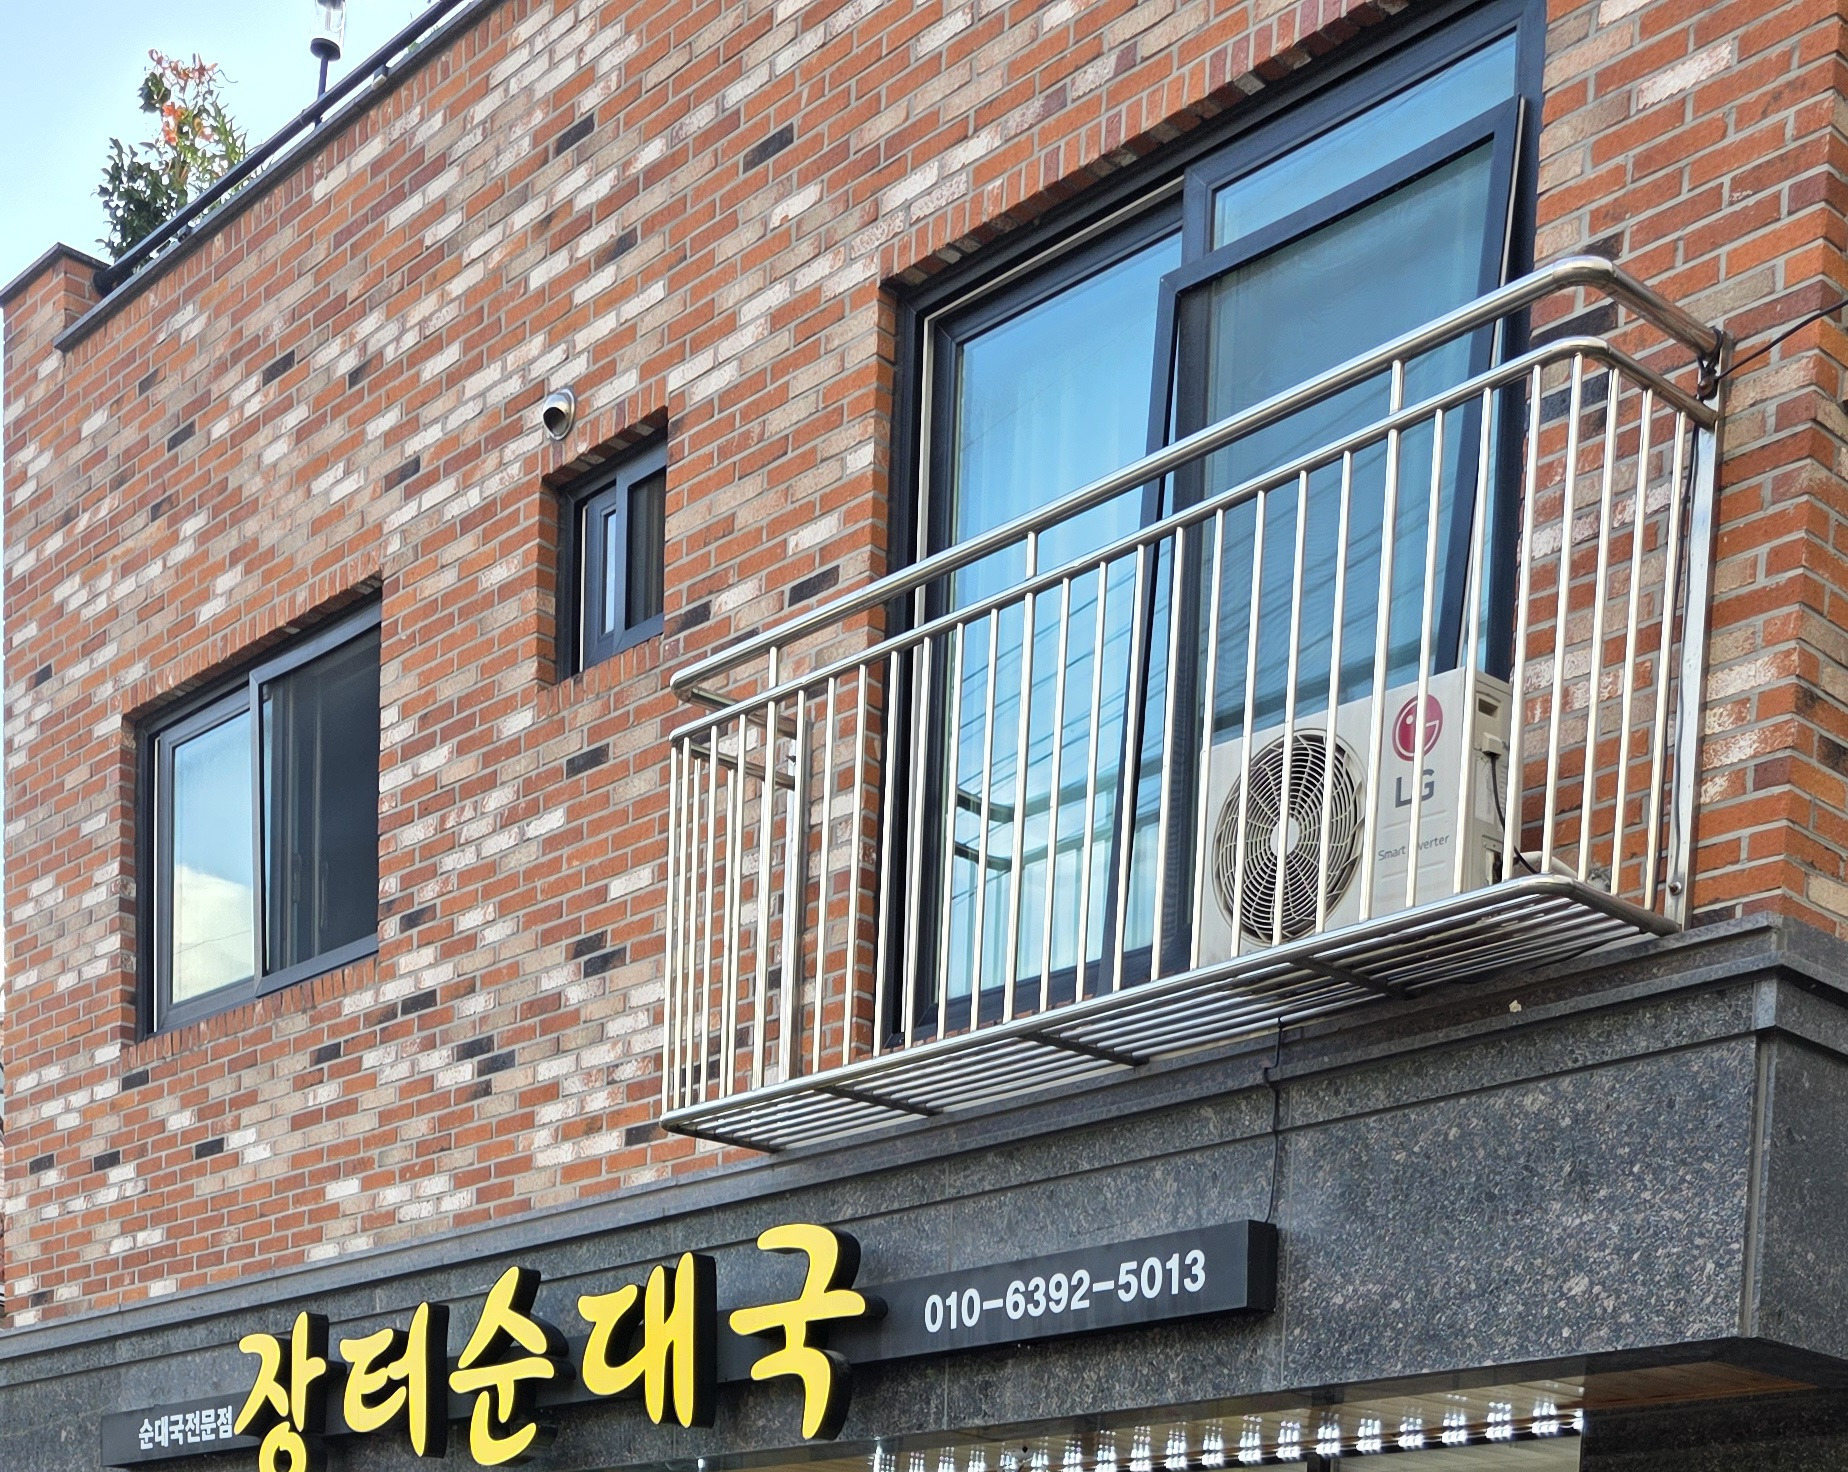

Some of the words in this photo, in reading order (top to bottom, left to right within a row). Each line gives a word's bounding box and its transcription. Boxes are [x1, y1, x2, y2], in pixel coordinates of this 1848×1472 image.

[1395, 769, 1435, 808] LG
[1378, 845, 1406, 861] Smart
[1413, 835, 1449, 851] verter
[924, 1249, 1206, 1333] 010-6392-5013
[138, 1405, 233, 1450] 순대국전문점
